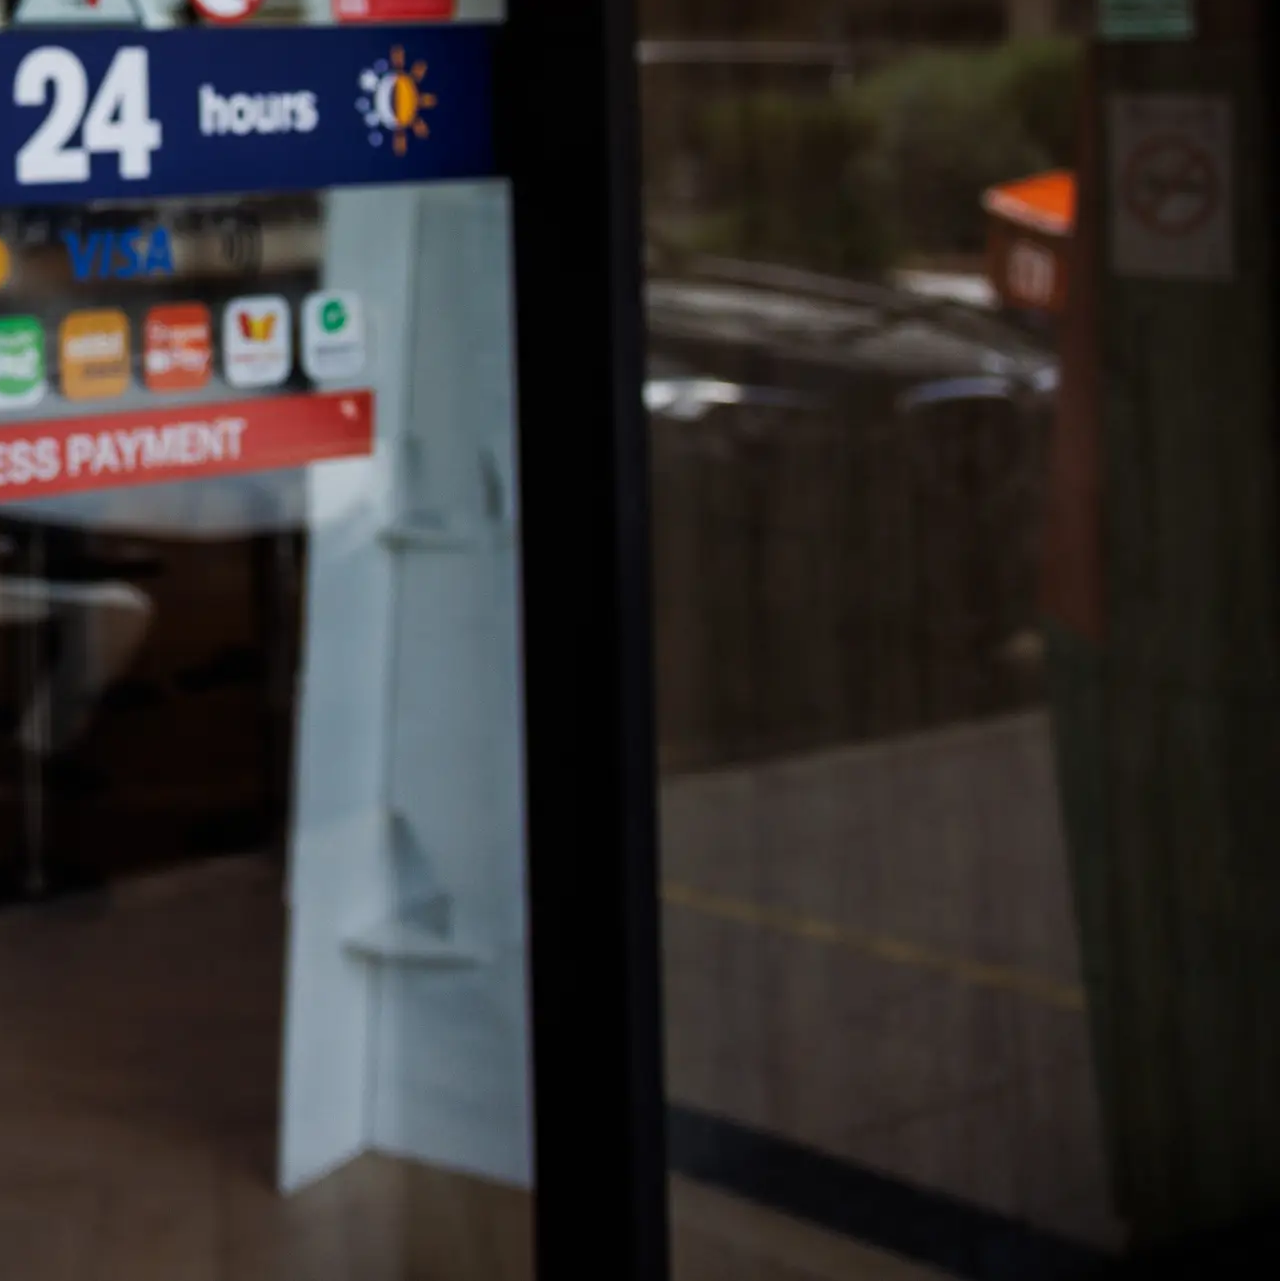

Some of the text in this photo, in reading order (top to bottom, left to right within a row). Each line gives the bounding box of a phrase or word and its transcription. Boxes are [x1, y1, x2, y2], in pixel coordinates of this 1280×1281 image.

[15, 47, 161, 184] 24
[200, 86, 317, 135] hours
[66, 228, 174, 278] VISA
[67, 418, 246, 476] PAYMENT
